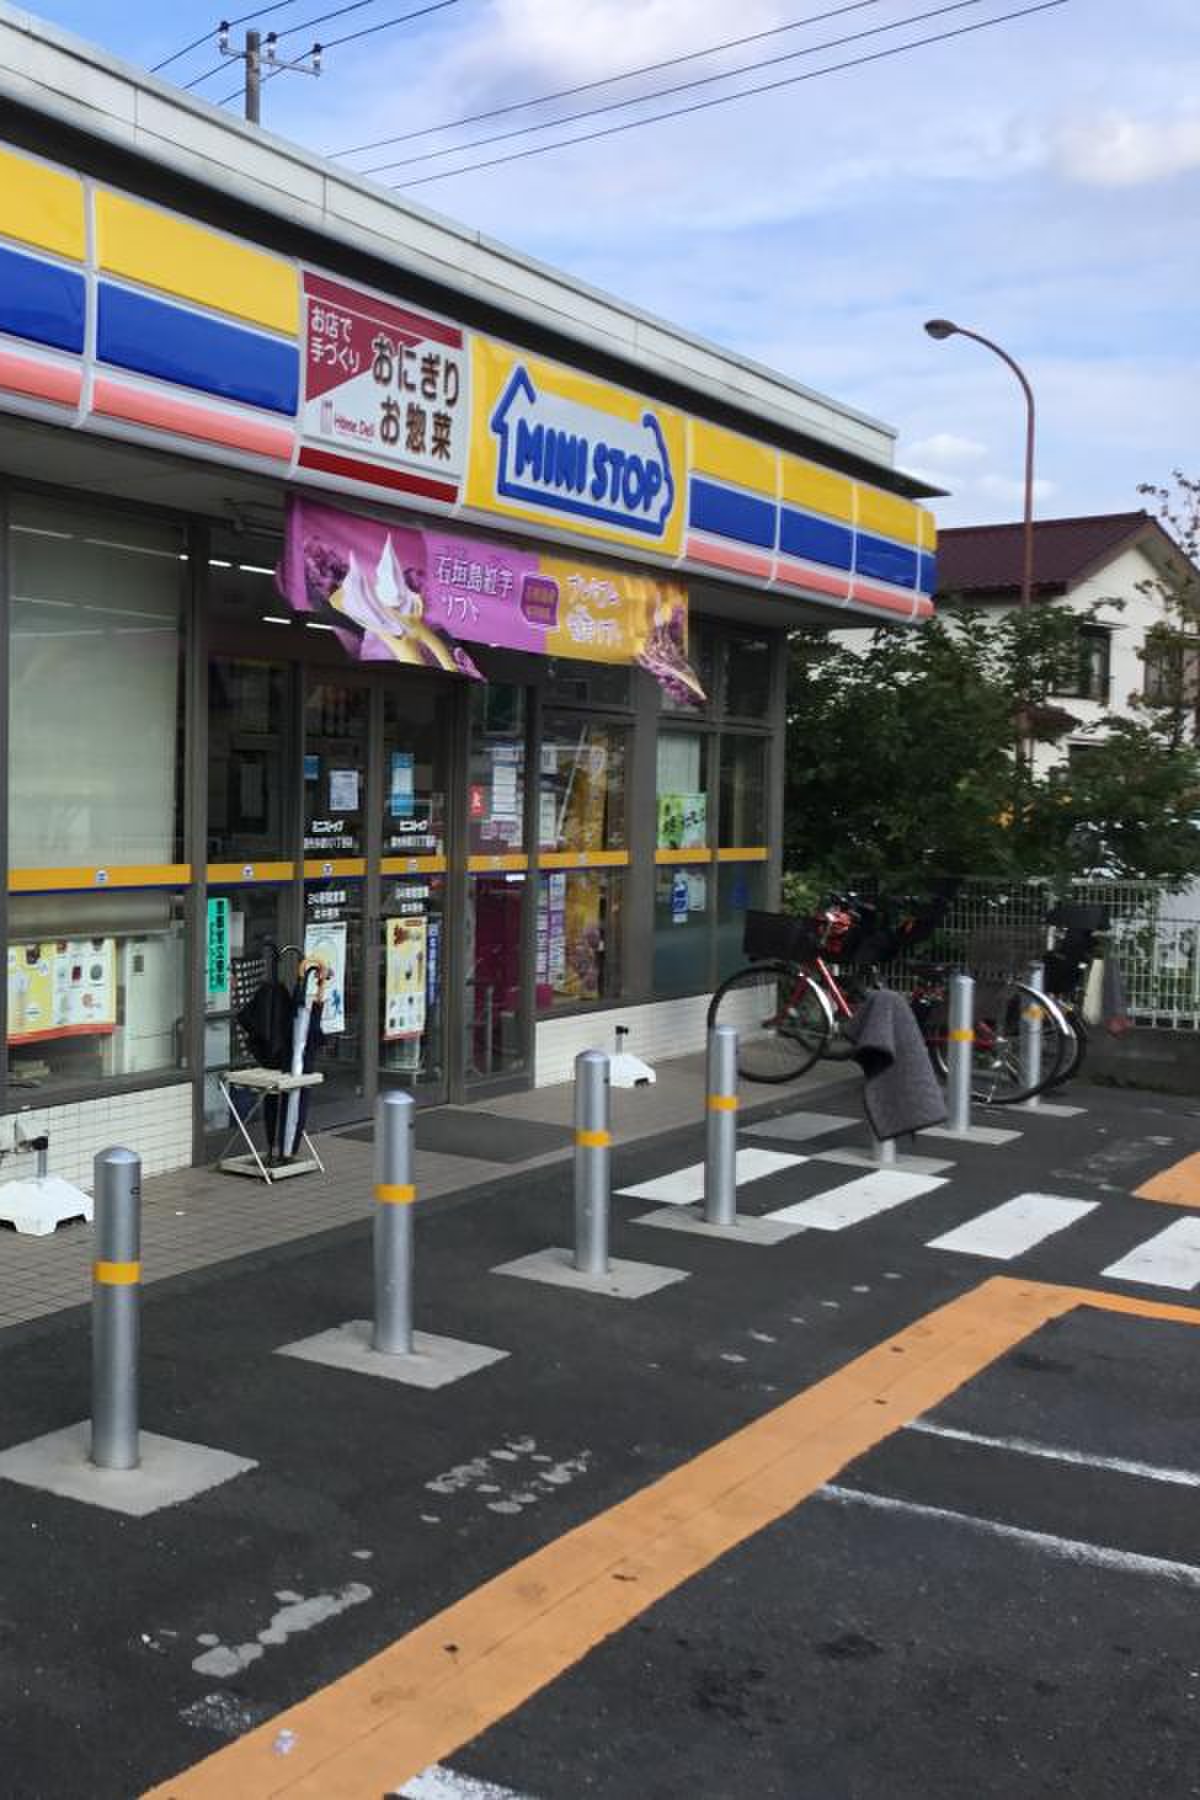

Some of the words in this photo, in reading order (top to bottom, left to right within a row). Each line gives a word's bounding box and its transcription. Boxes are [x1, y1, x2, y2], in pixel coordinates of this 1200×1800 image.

[311, 305, 353, 338] お店で
[311, 341, 361, 374] 手づくり
[371, 332, 460, 408] おにぎり
[379, 396, 453, 461] お惣菜
[514, 417, 588, 494] MINI
[590, 442, 663, 512] STOP
[442, 594, 481, 623] ソフト
